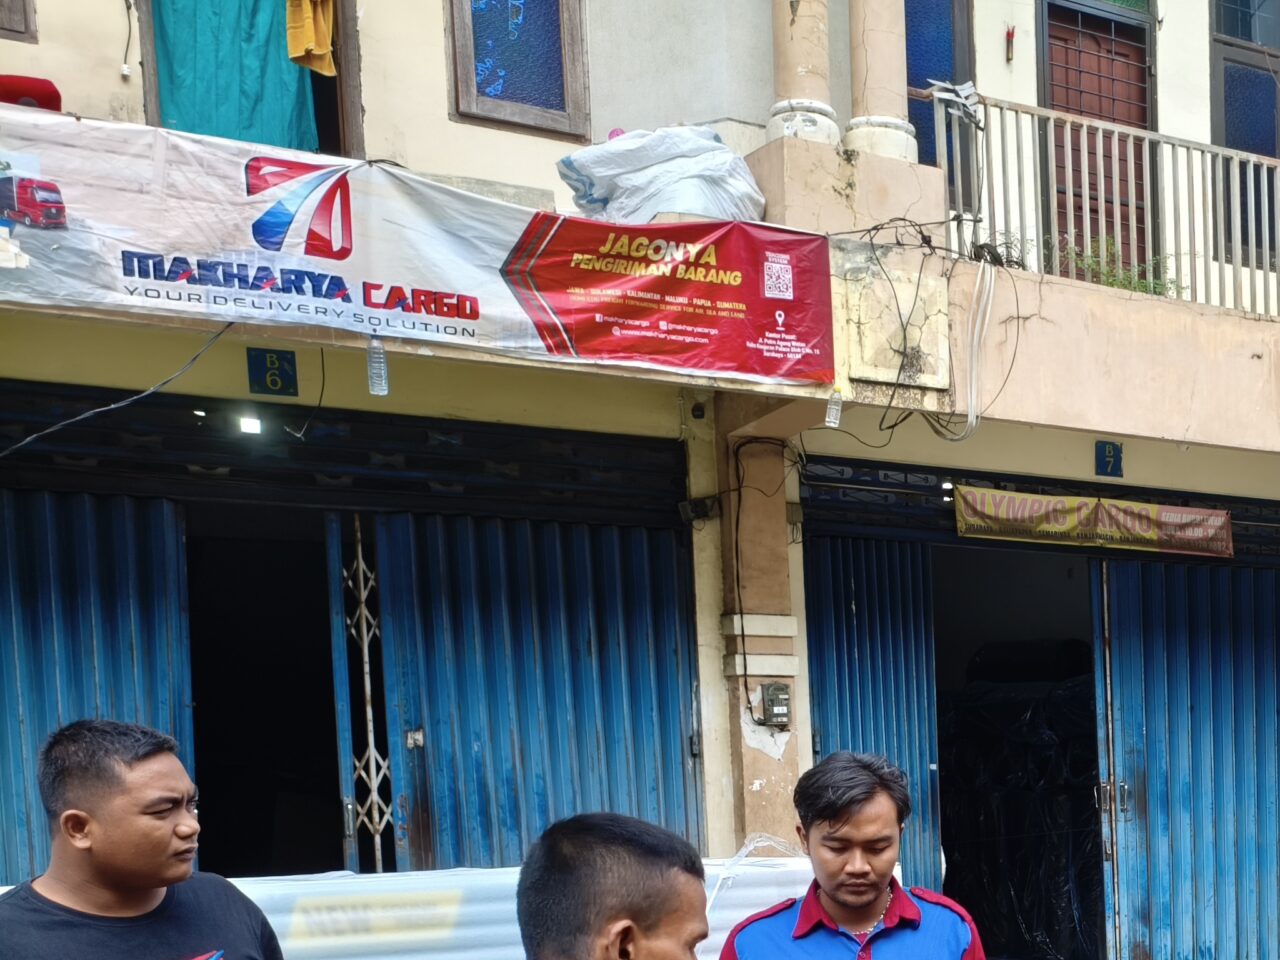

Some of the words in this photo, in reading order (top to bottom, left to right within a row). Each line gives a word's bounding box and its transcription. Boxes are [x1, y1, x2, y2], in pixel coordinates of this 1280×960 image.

[599, 233, 717, 267] JAGONYA
[570, 253, 673, 279] PENGIRIMAN
[676, 263, 742, 287] BARANG
[122, 250, 353, 302] MAKHARYA
[362, 281, 480, 320] CARGO
[123, 285, 203, 304] YOUR
[213, 295, 344, 319] DELIVERY
[353, 313, 476, 338] SOLUTION
[665, 295, 688, 304] MALUKU
[693, 298, 711, 307] PAPUA
[717, 301, 746, 310] SUMATERA
[621, 329, 709, 343] www.makharyacargo.com
[265, 354, 279, 368] B
[265, 370, 282, 390] 6
[1105, 445, 1114, 456] B
[1105, 459, 1115, 472] 7
[962, 490, 1068, 528] OLYMPIC
[1076, 500, 1153, 534] CARGO
